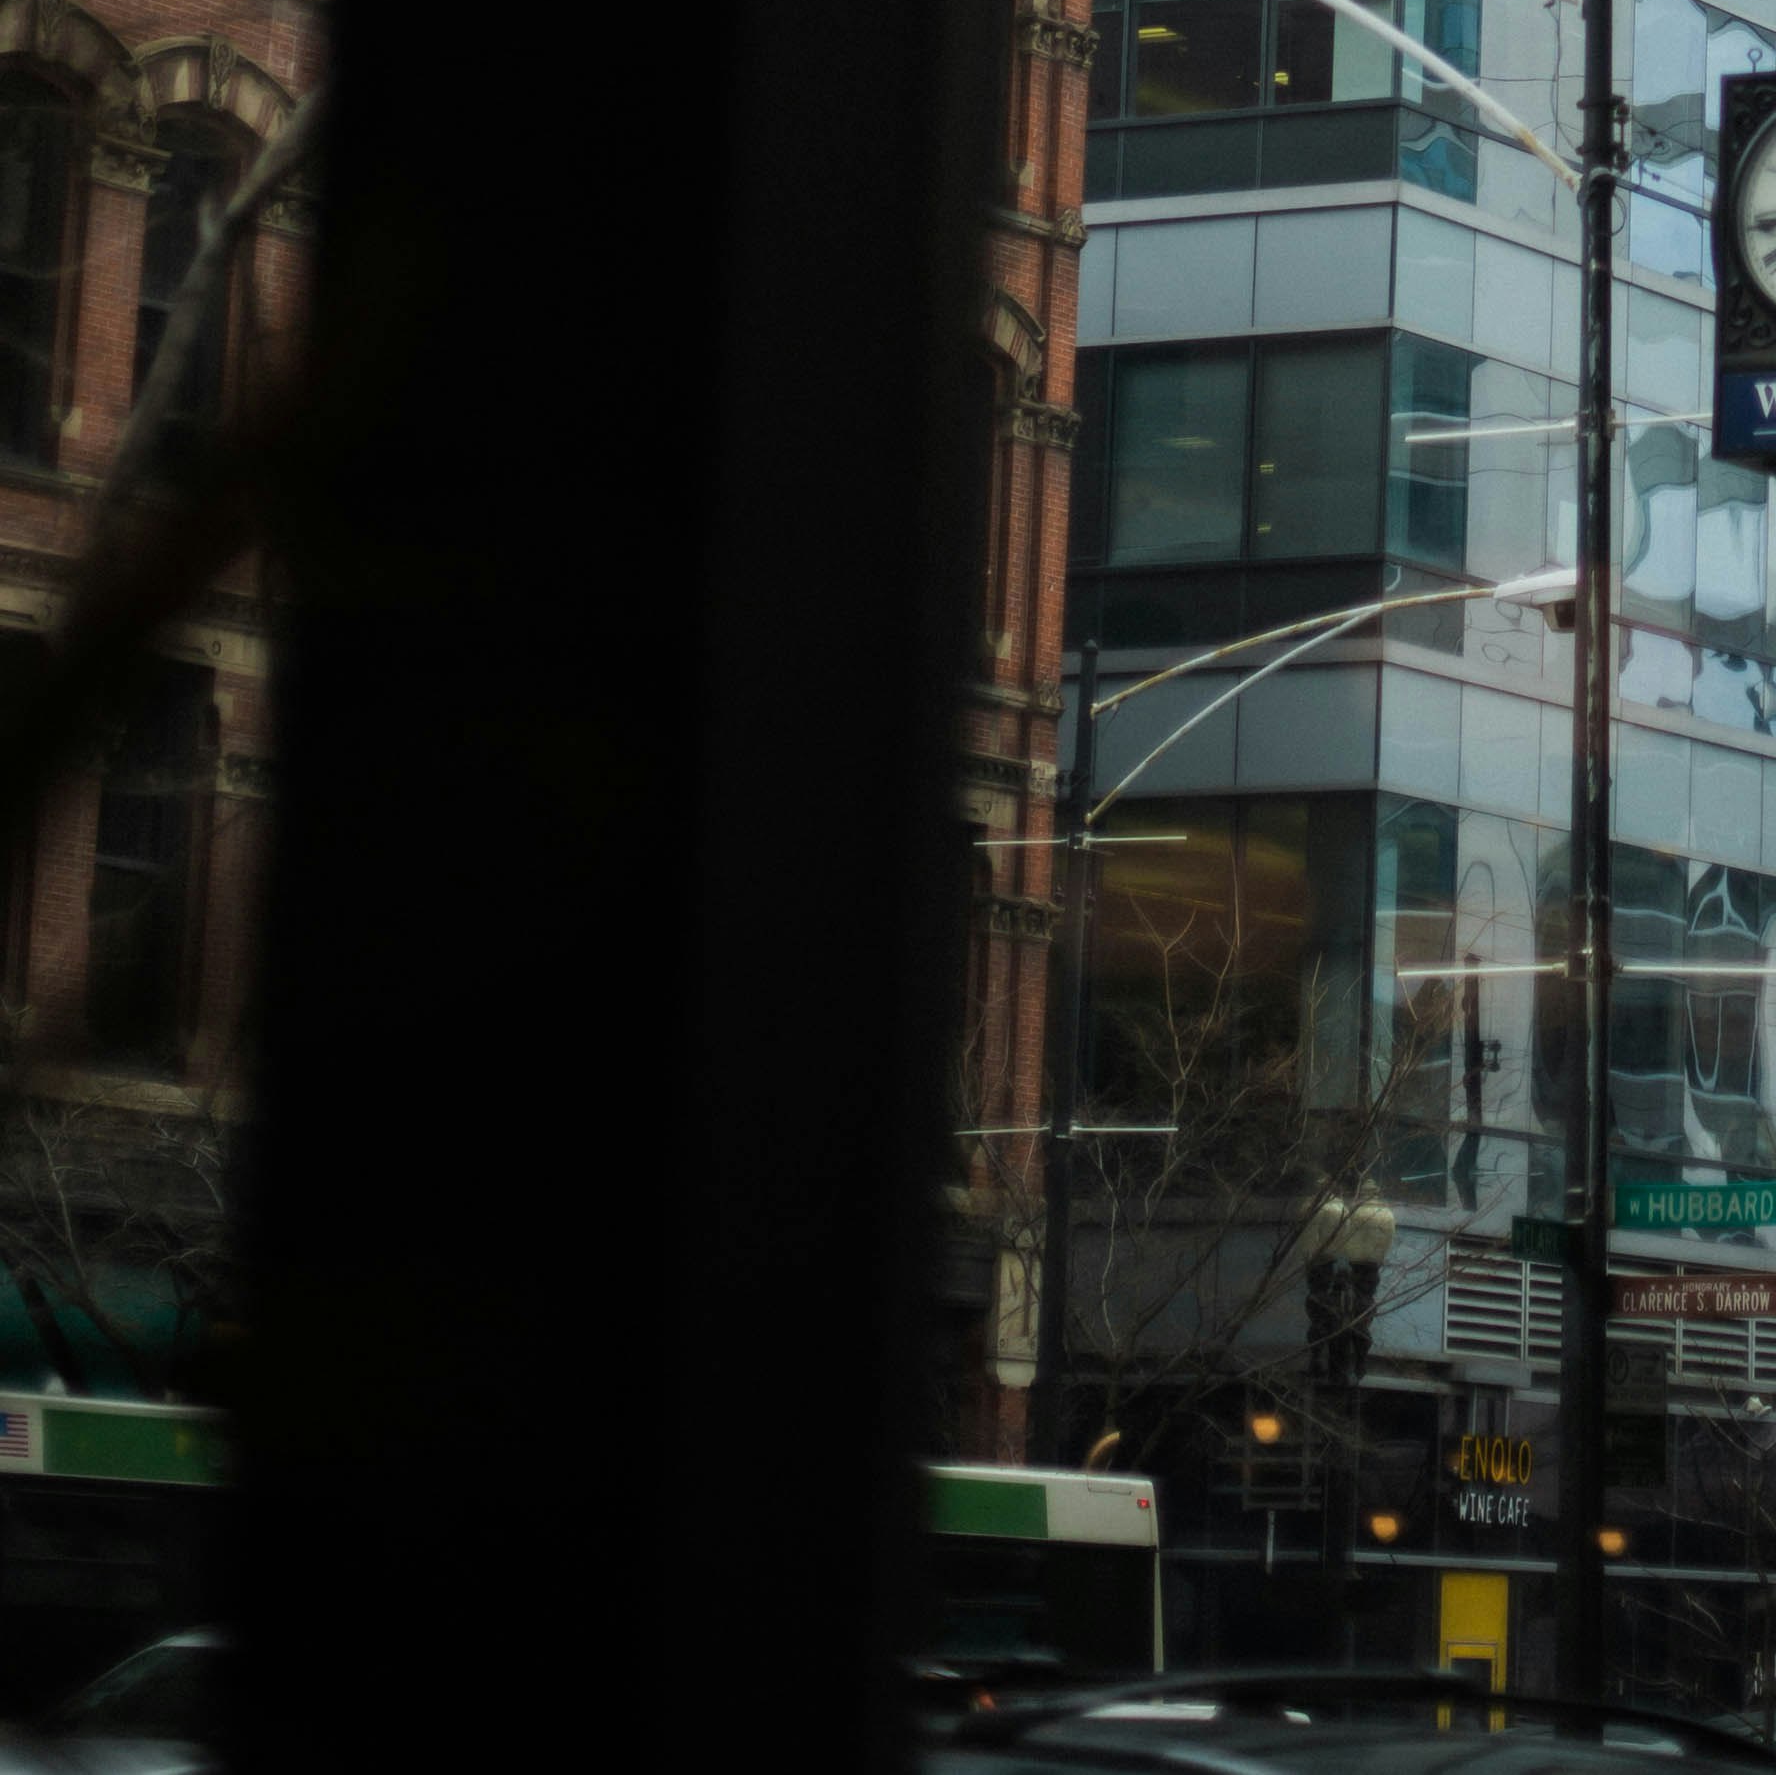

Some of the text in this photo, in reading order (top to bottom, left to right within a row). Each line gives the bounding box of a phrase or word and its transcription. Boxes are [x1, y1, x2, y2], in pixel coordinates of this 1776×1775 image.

[1629, 1198, 1641, 1217] W
[1647, 1189, 1774, 1223] HUBBARD
[1622, 1290, 1688, 1313] CLARENCE
[1696, 1291, 1709, 1313] S.
[1715, 1290, 1771, 1312] DARROW
[1681, 1281, 1732, 1293] HONORARY
[1459, 1434, 1533, 1487] ENOLO
[1458, 1490, 1530, 1528] WINE CAFE
